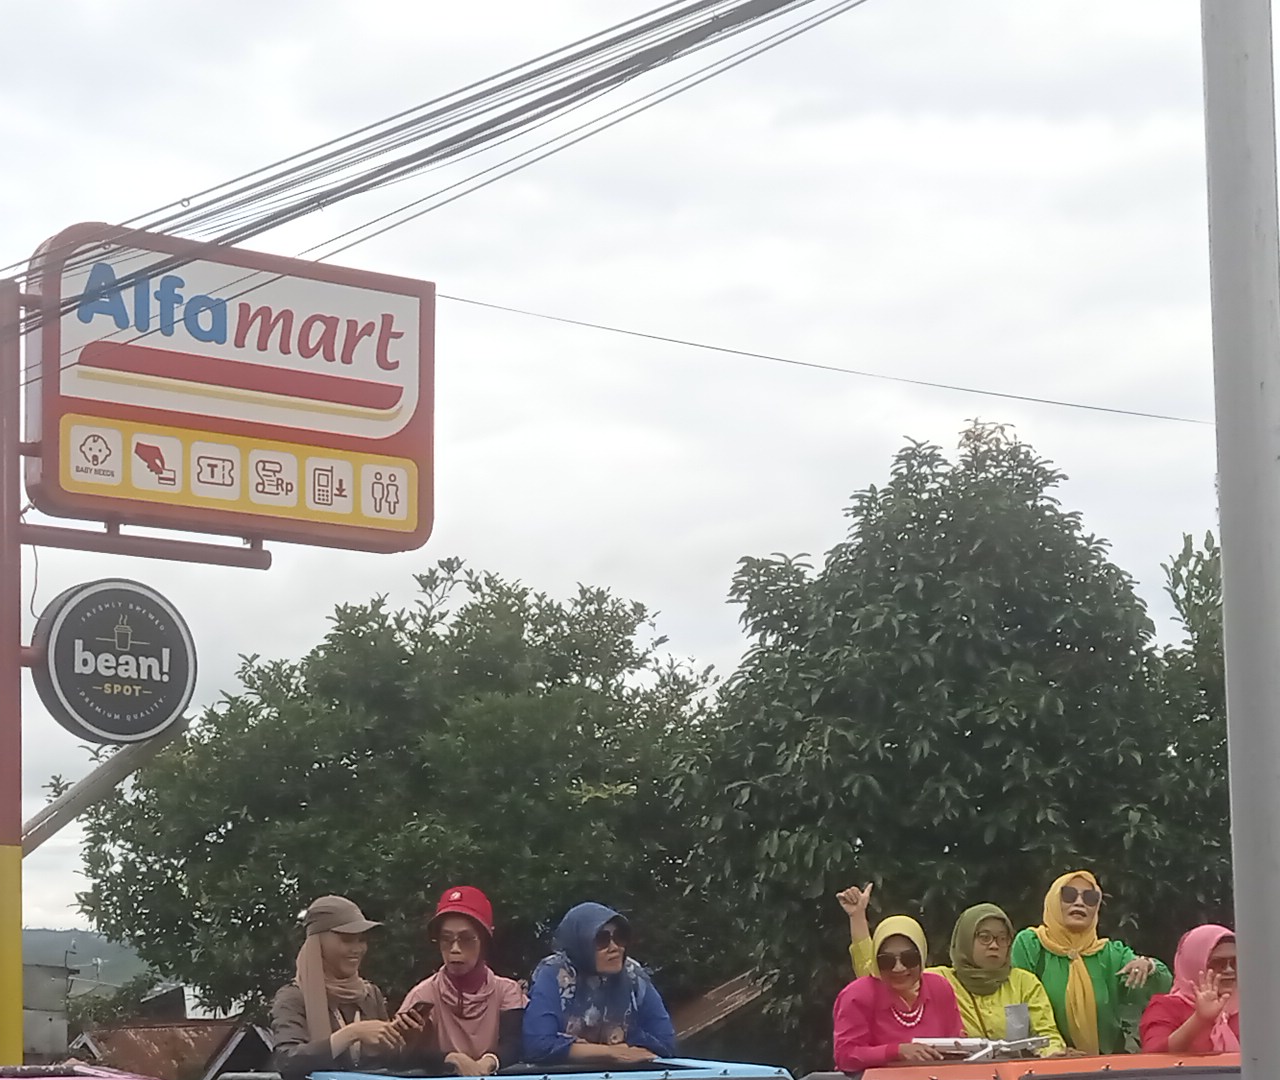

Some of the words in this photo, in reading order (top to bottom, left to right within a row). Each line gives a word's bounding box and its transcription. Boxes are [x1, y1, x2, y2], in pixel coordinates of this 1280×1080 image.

[76, 262, 405, 371] Alfamart
[276, 477, 294, 496] Rp
[74, 639, 171, 682] bean!
[103, 683, 142, 697] SPOT
[79, 691, 120, 719] PREMIUM
[126, 697, 164, 721] QUALITY
